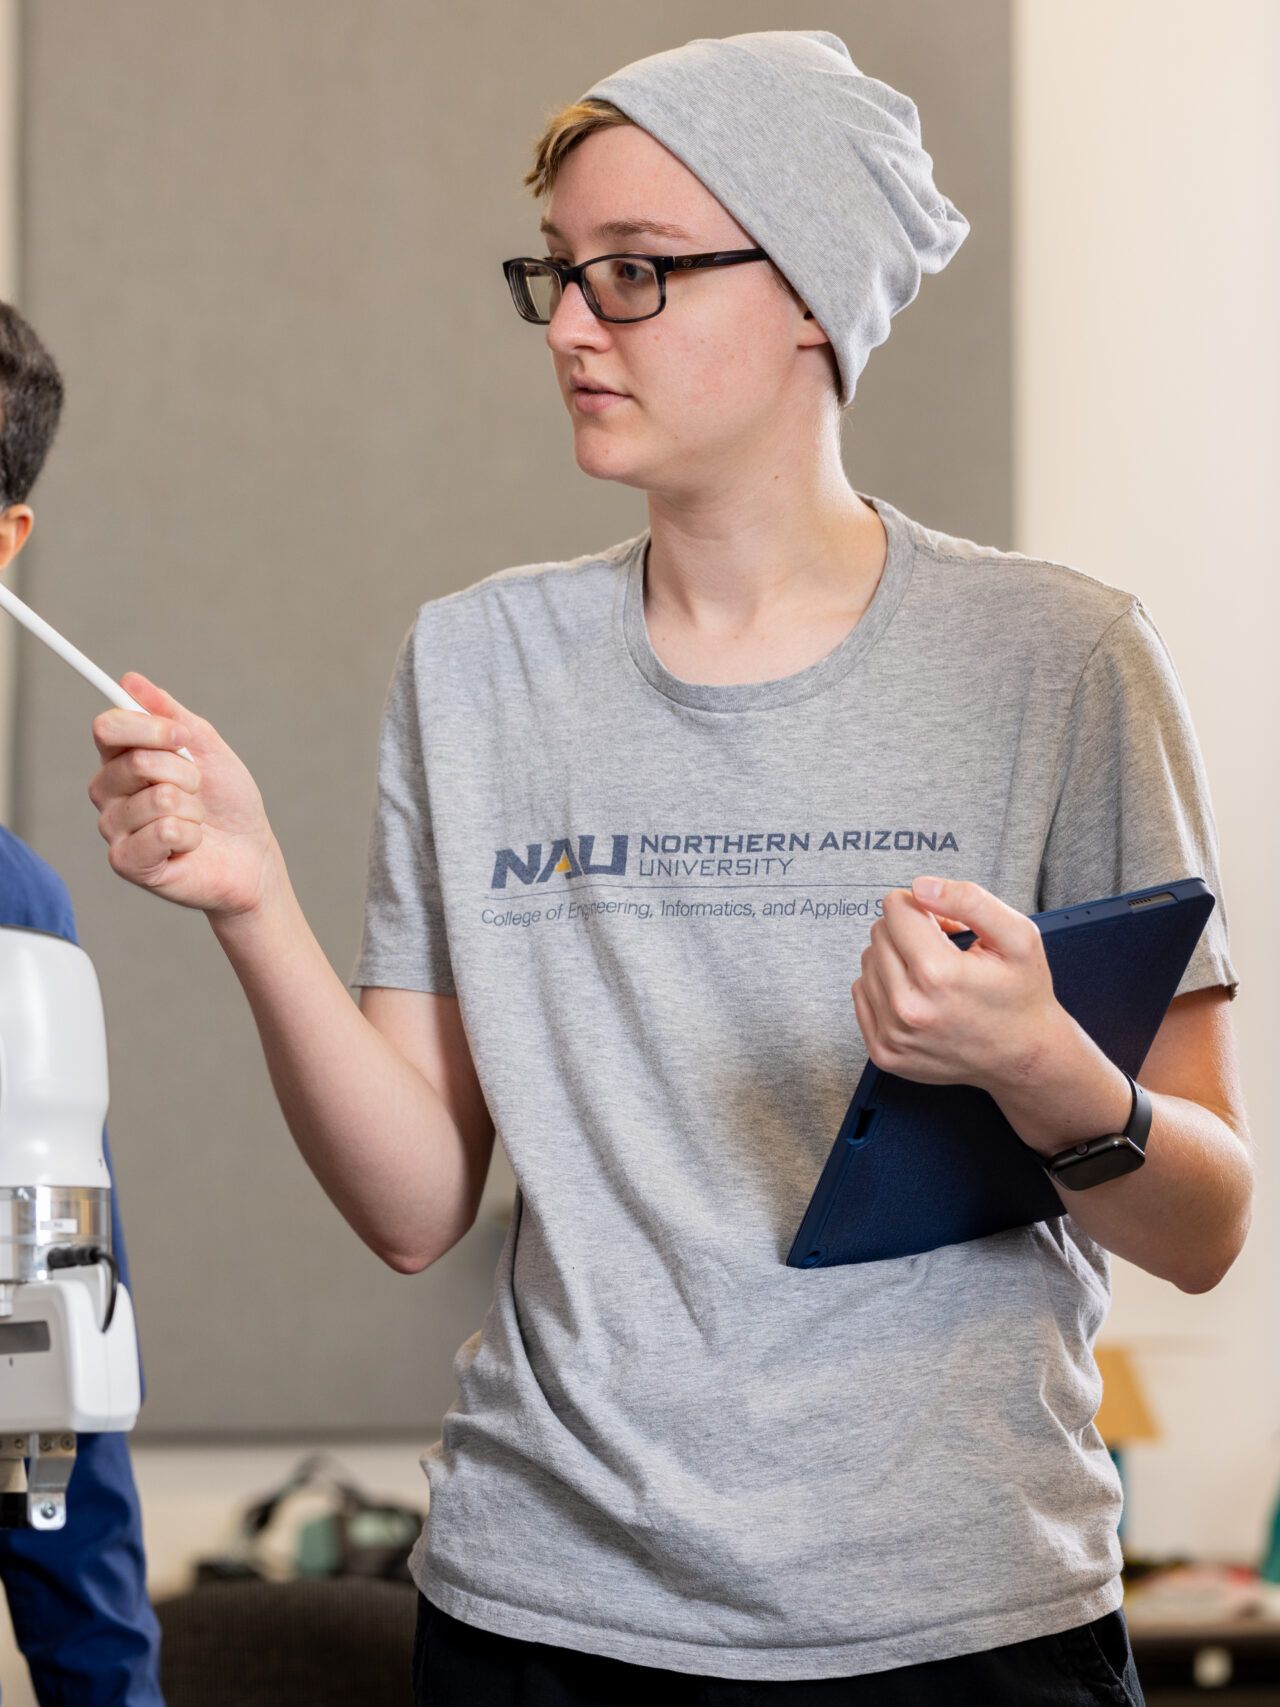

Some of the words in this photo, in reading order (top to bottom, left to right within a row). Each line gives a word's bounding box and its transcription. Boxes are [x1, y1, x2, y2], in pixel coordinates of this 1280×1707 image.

[640, 833, 810, 854] NORTHERN
[819, 831, 959, 852] ARIZONA
[491, 834, 629, 889] NAU
[639, 857, 794, 877] UNIVERSITY
[481, 908, 542, 928] College
[546, 903, 564, 921] of
[661, 899, 756, 919] Informatics,
[762, 900, 796, 917] and
[800, 899, 869, 920] Applied
